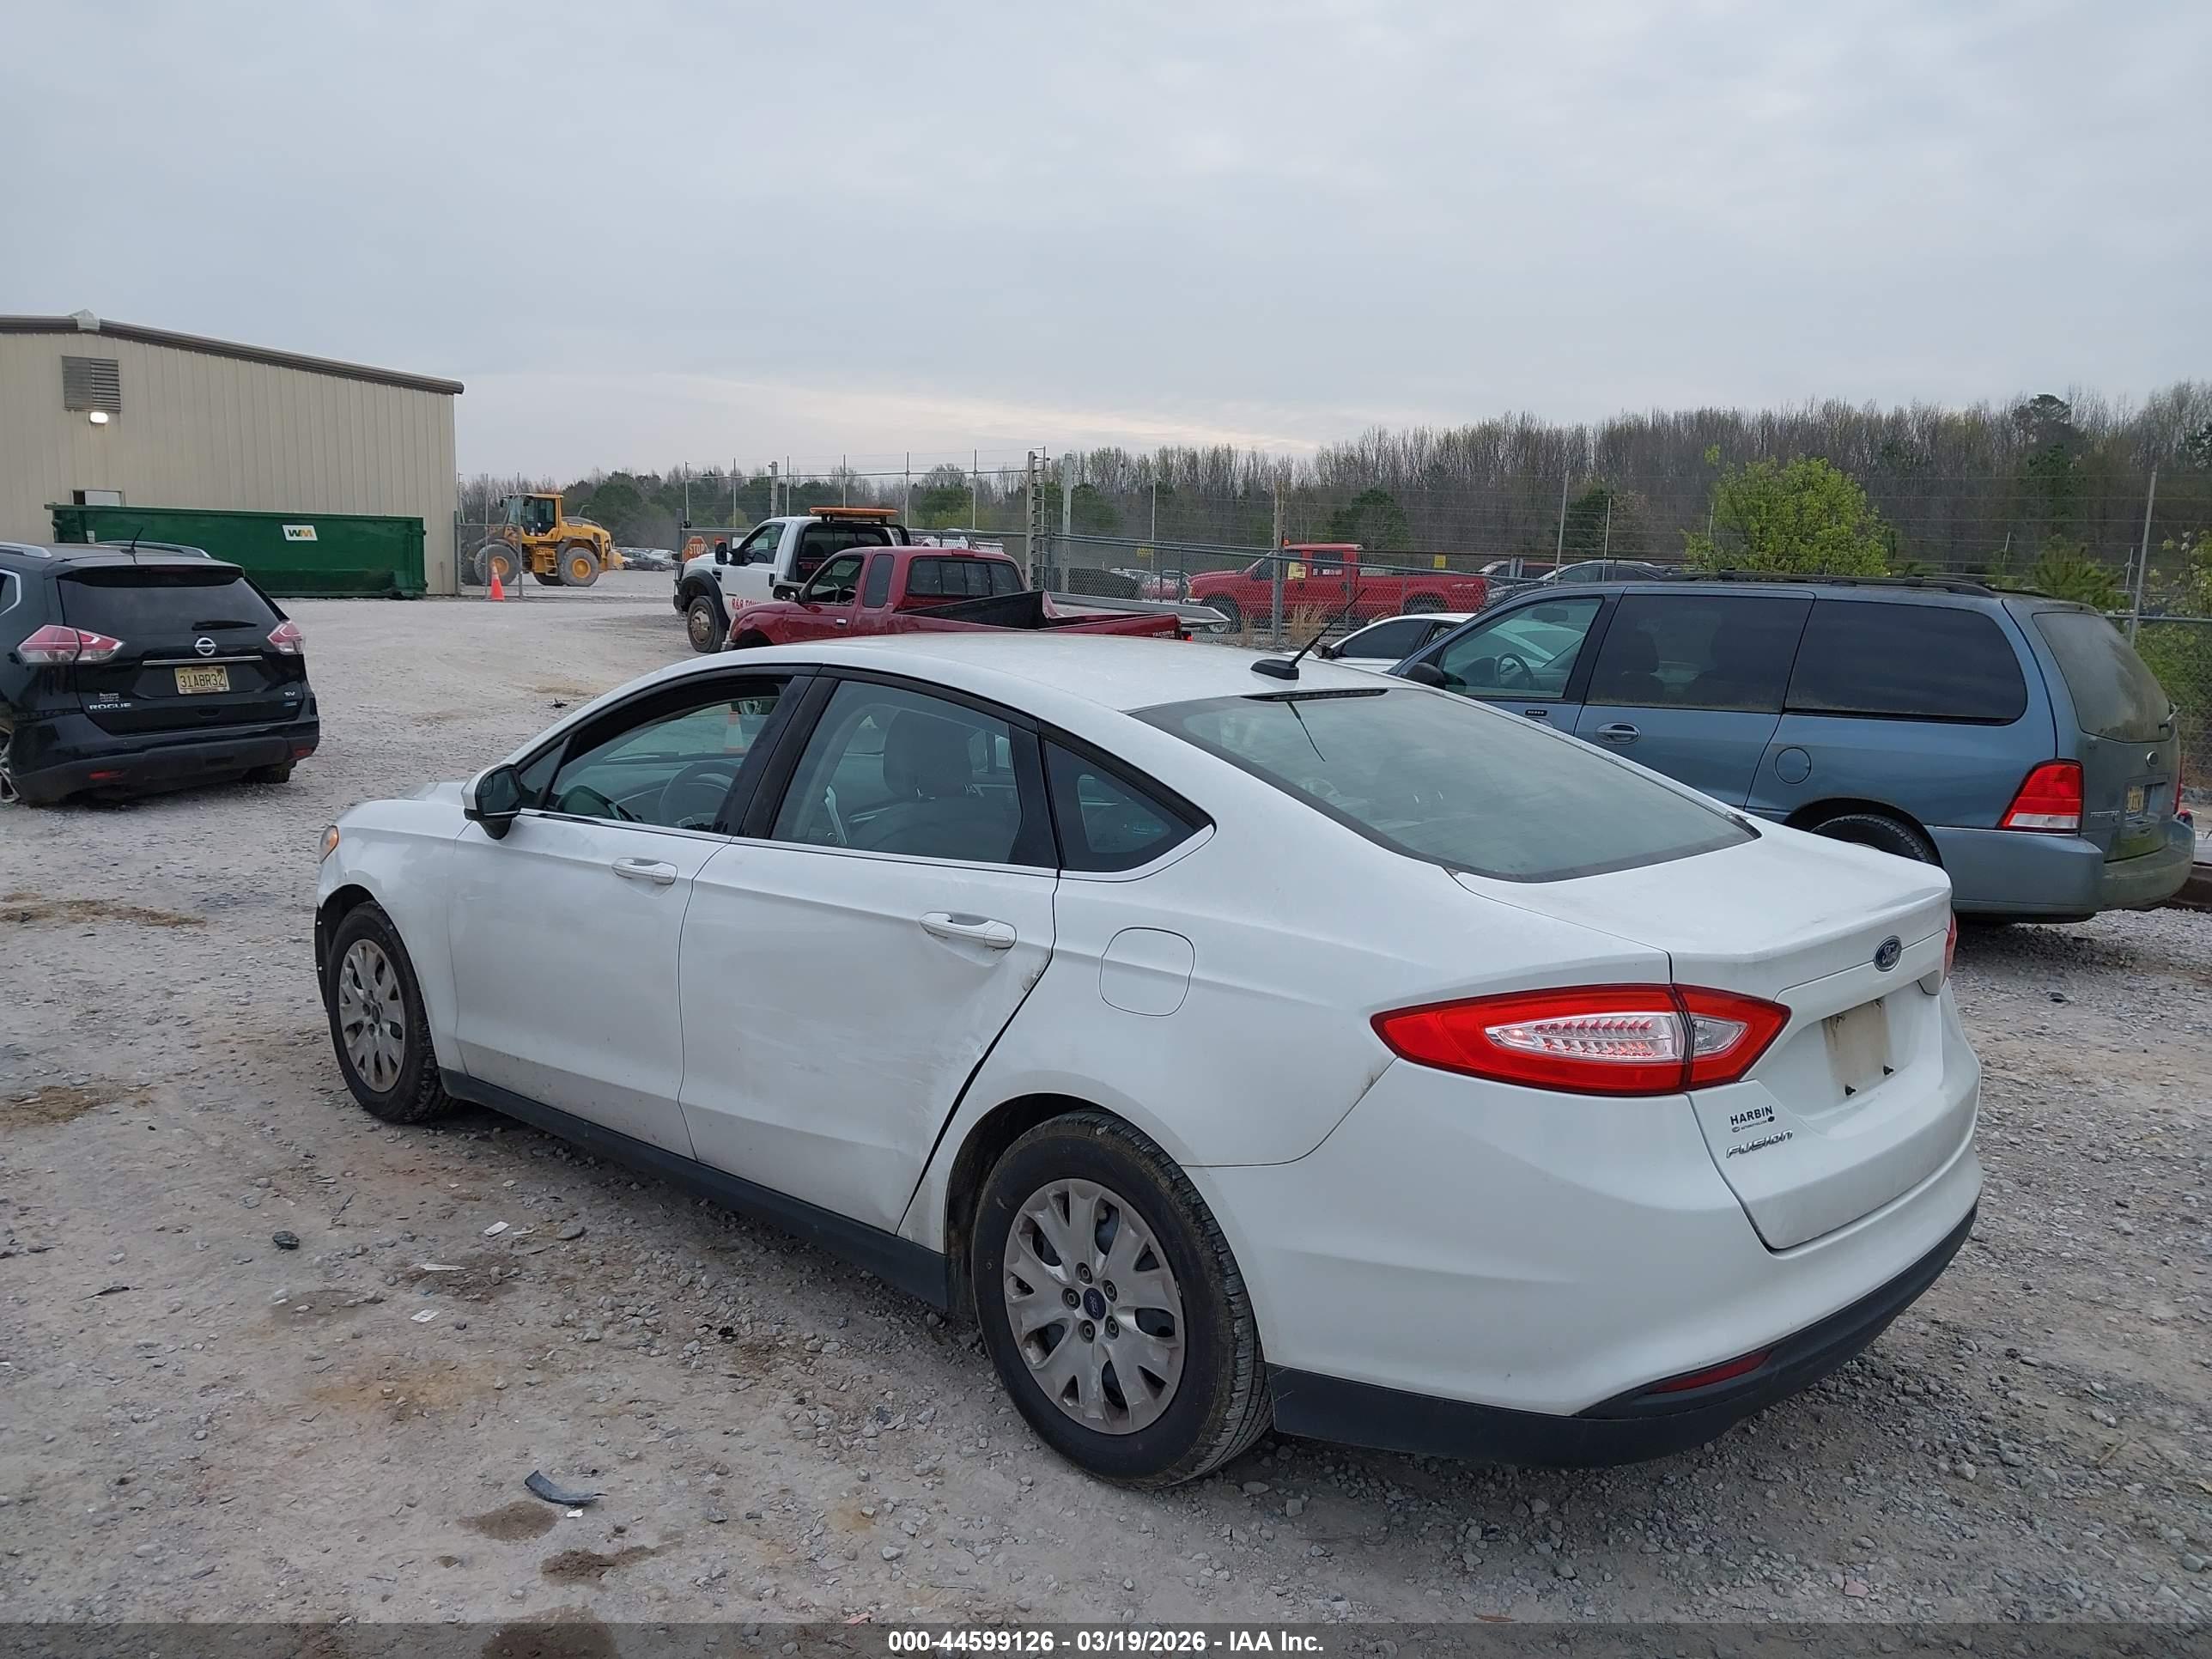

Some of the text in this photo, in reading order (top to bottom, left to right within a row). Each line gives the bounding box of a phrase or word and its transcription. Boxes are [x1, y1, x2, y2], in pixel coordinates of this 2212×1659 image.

[287, 528, 313, 538] WM
[689, 543, 705, 555] STOP
[179, 673, 225, 688] 31ABR32
[1729, 1105, 1773, 1126] HARBIN
